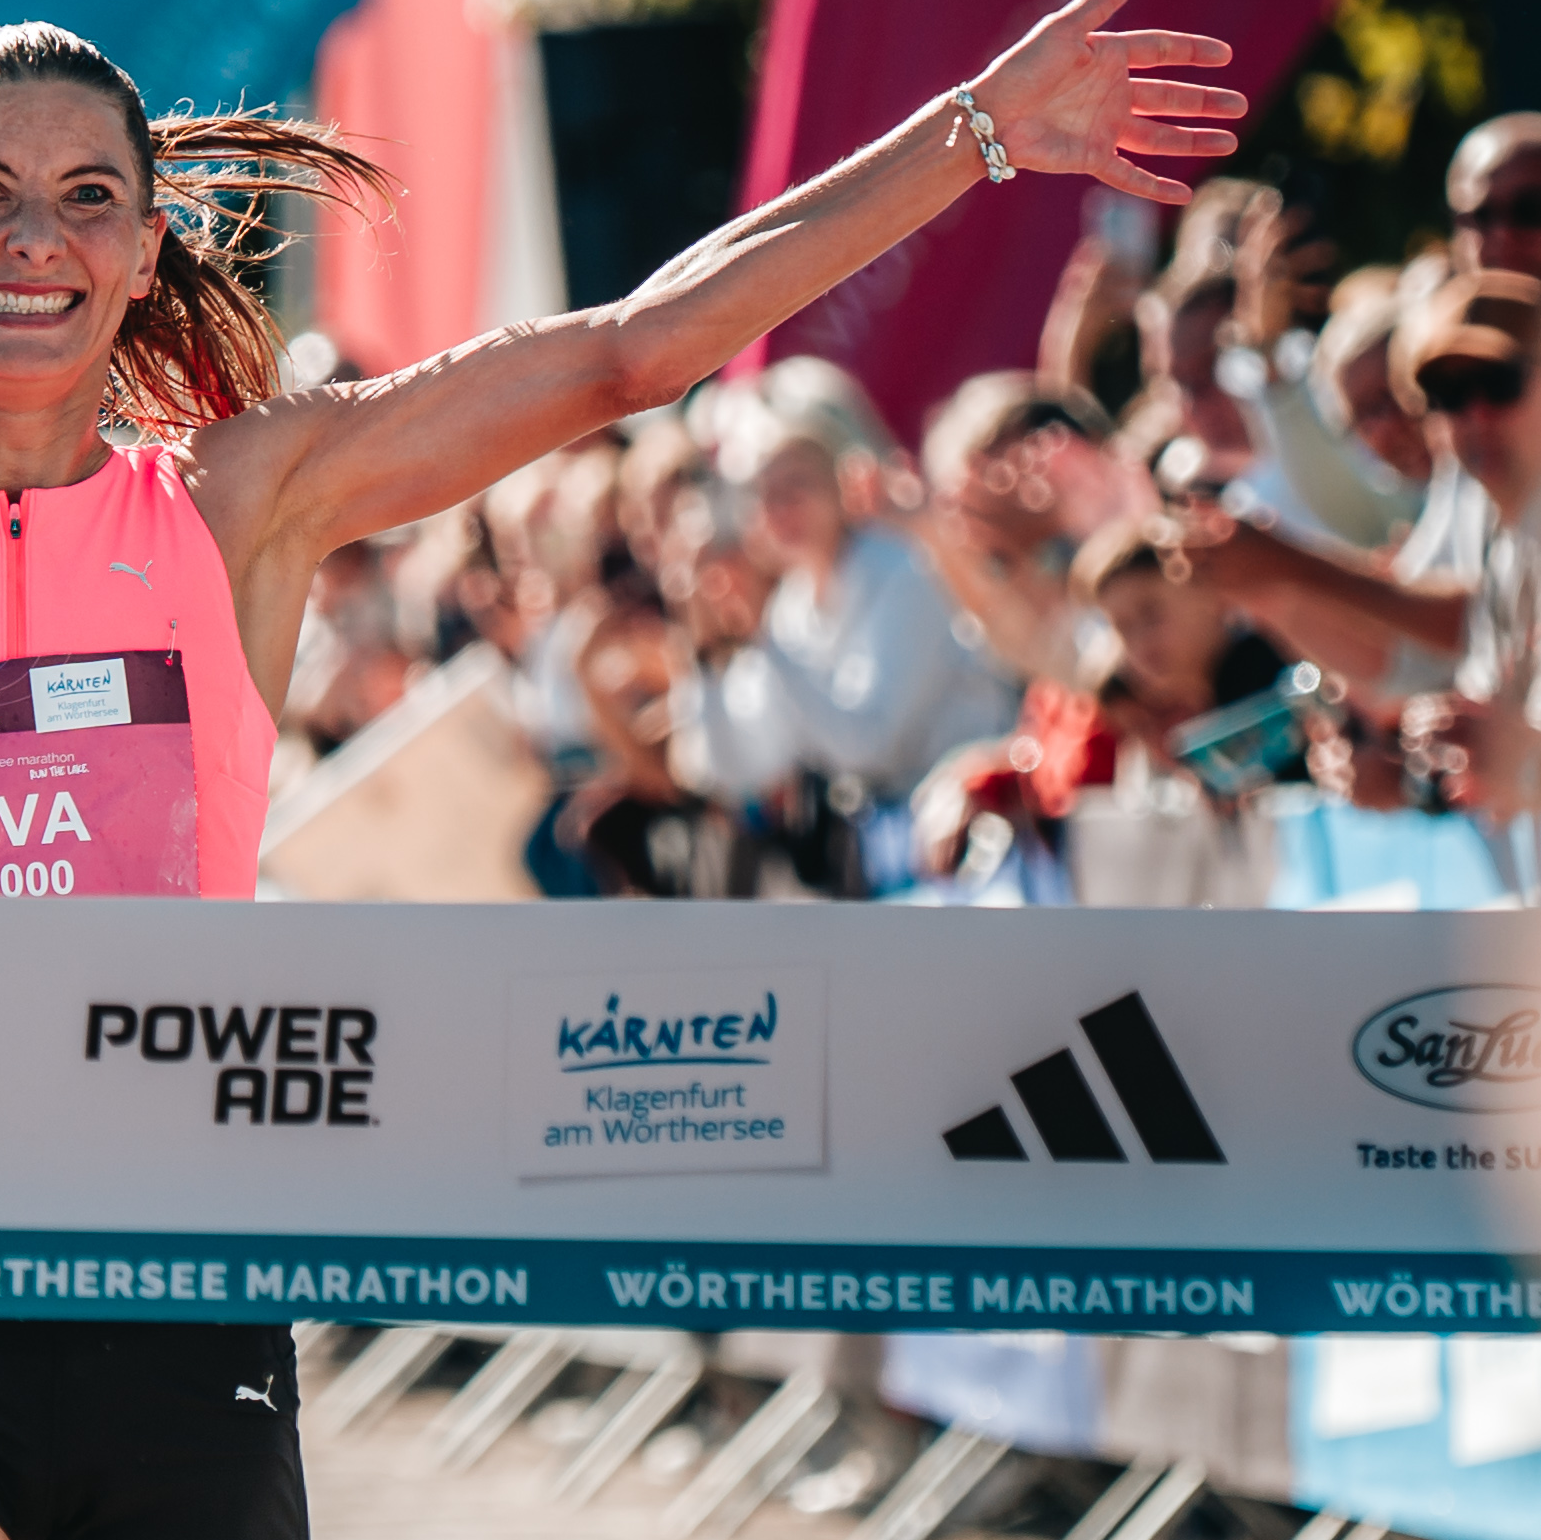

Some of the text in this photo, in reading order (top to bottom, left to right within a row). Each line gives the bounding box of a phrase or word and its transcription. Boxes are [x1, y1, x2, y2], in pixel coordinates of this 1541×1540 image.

[46, 714, 62, 723] am
[57, 698, 106, 713] Klagenfurt
[17, 752, 75, 766] marathon
[29, 769, 47, 780] RUN
[49, 765, 66, 777] THE
[85, 1003, 378, 1066] POWER
[586, 1082, 747, 1120] Klagenfurt
[544, 1124, 594, 1147] am
[1356, 1142, 1438, 1170] Taste
[1446, 1143, 1496, 1171] the
[245, 1262, 528, 1307] MARATHON
[605, 1262, 1256, 1317] WÖRTHERSEE MARATHON
